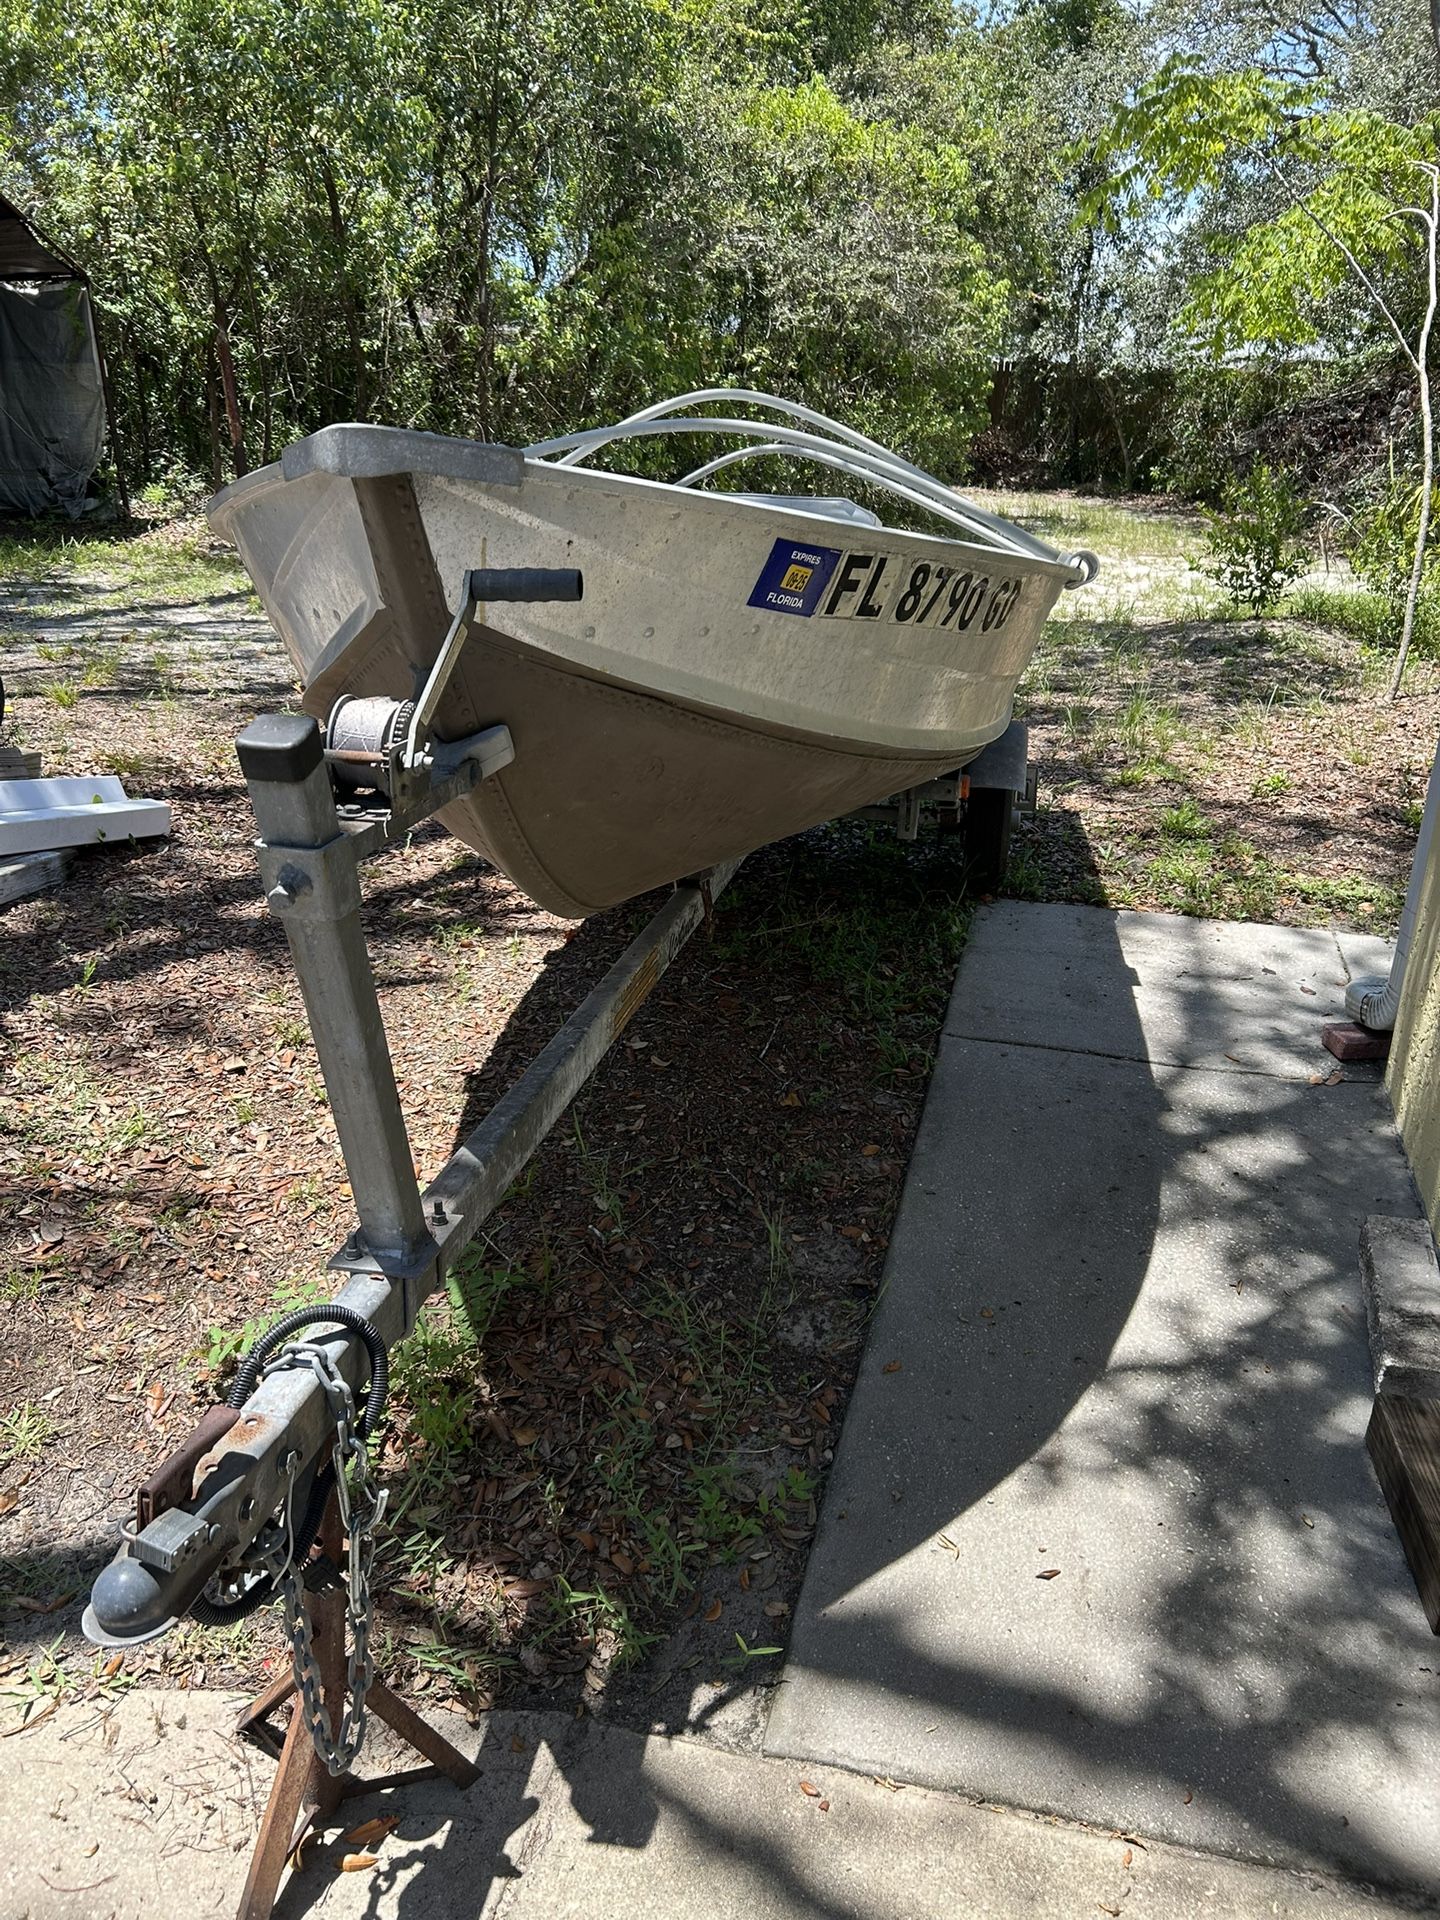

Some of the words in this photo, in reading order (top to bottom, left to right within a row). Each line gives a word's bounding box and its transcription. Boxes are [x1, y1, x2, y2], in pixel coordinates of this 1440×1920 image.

[791, 550, 822, 565] EXPIRES
[766, 592, 804, 608] FLORIDA
[824, 555, 888, 617] FL
[896, 563, 989, 631] 8790
